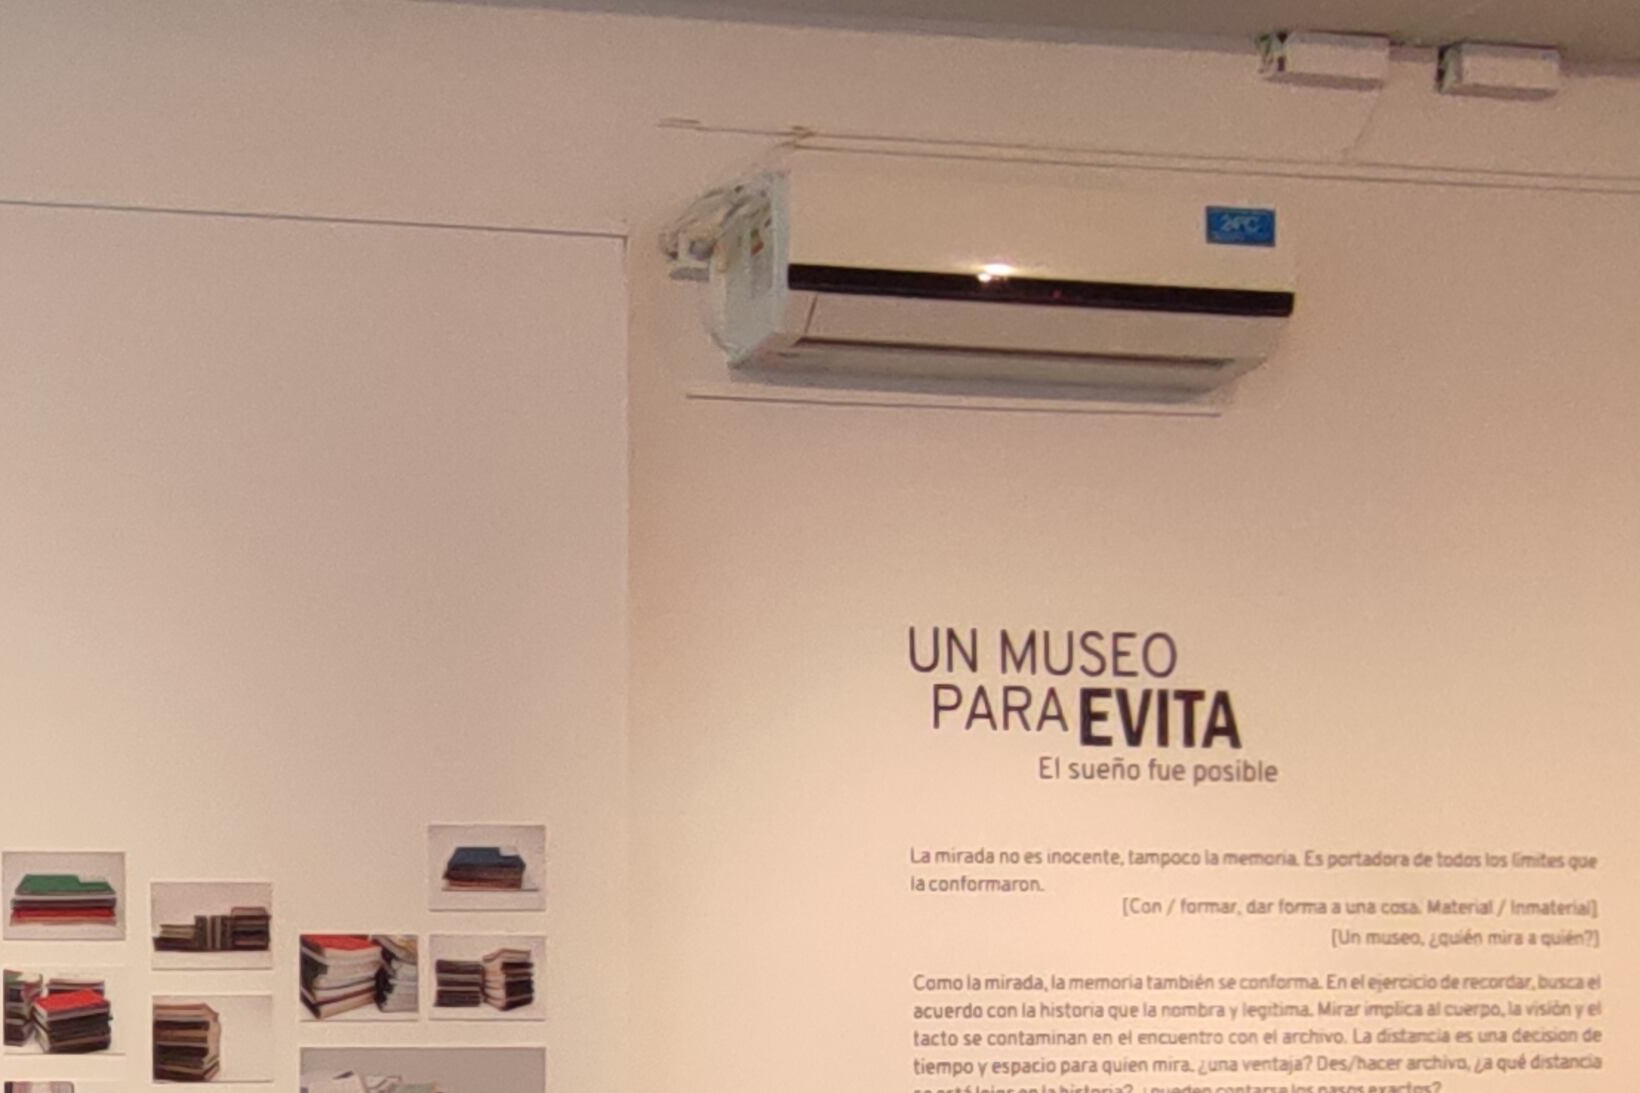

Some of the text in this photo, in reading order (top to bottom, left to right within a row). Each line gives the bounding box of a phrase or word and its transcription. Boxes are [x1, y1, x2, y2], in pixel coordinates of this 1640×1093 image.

[909, 626, 1177, 678] UN MUSEO
[932, 684, 1242, 749] PARA EVITA
[1039, 756, 1278, 787] El sueño fue posible
[911, 848, 931, 865] La
[935, 847, 995, 864] mirada
[1000, 851, 1020, 864] no
[1024, 851, 1042, 864] es
[1128, 849, 1201, 869] tampoco
[1205, 850, 1219, 866] la
[1304, 849, 1324, 867] Es
[1327, 851, 1410, 870] portadora
[911, 876, 925, 891] la
[1123, 897, 1162, 918] [Con
[1427, 899, 1493, 915] Material
[1511, 898, 1598, 919] Inmaterial]
[1332, 928, 1524, 950] [Un ¿quién mira
[913, 973, 963, 991] Como
[967, 974, 981, 991] la
[1051, 974, 1065, 990] la
[1069, 976, 1143, 990] memoria
[1146, 974, 1214, 990] también
[1218, 977, 1236, 990] se
[914, 1001, 1238, 1021] acuerdo con la historia que la nombra y
[914, 1029, 1258, 1046] tacto se contaminan en el encuentro con
[914, 1054, 1402, 1078] tiempo y espacio para quien ¿una Des/hacer
